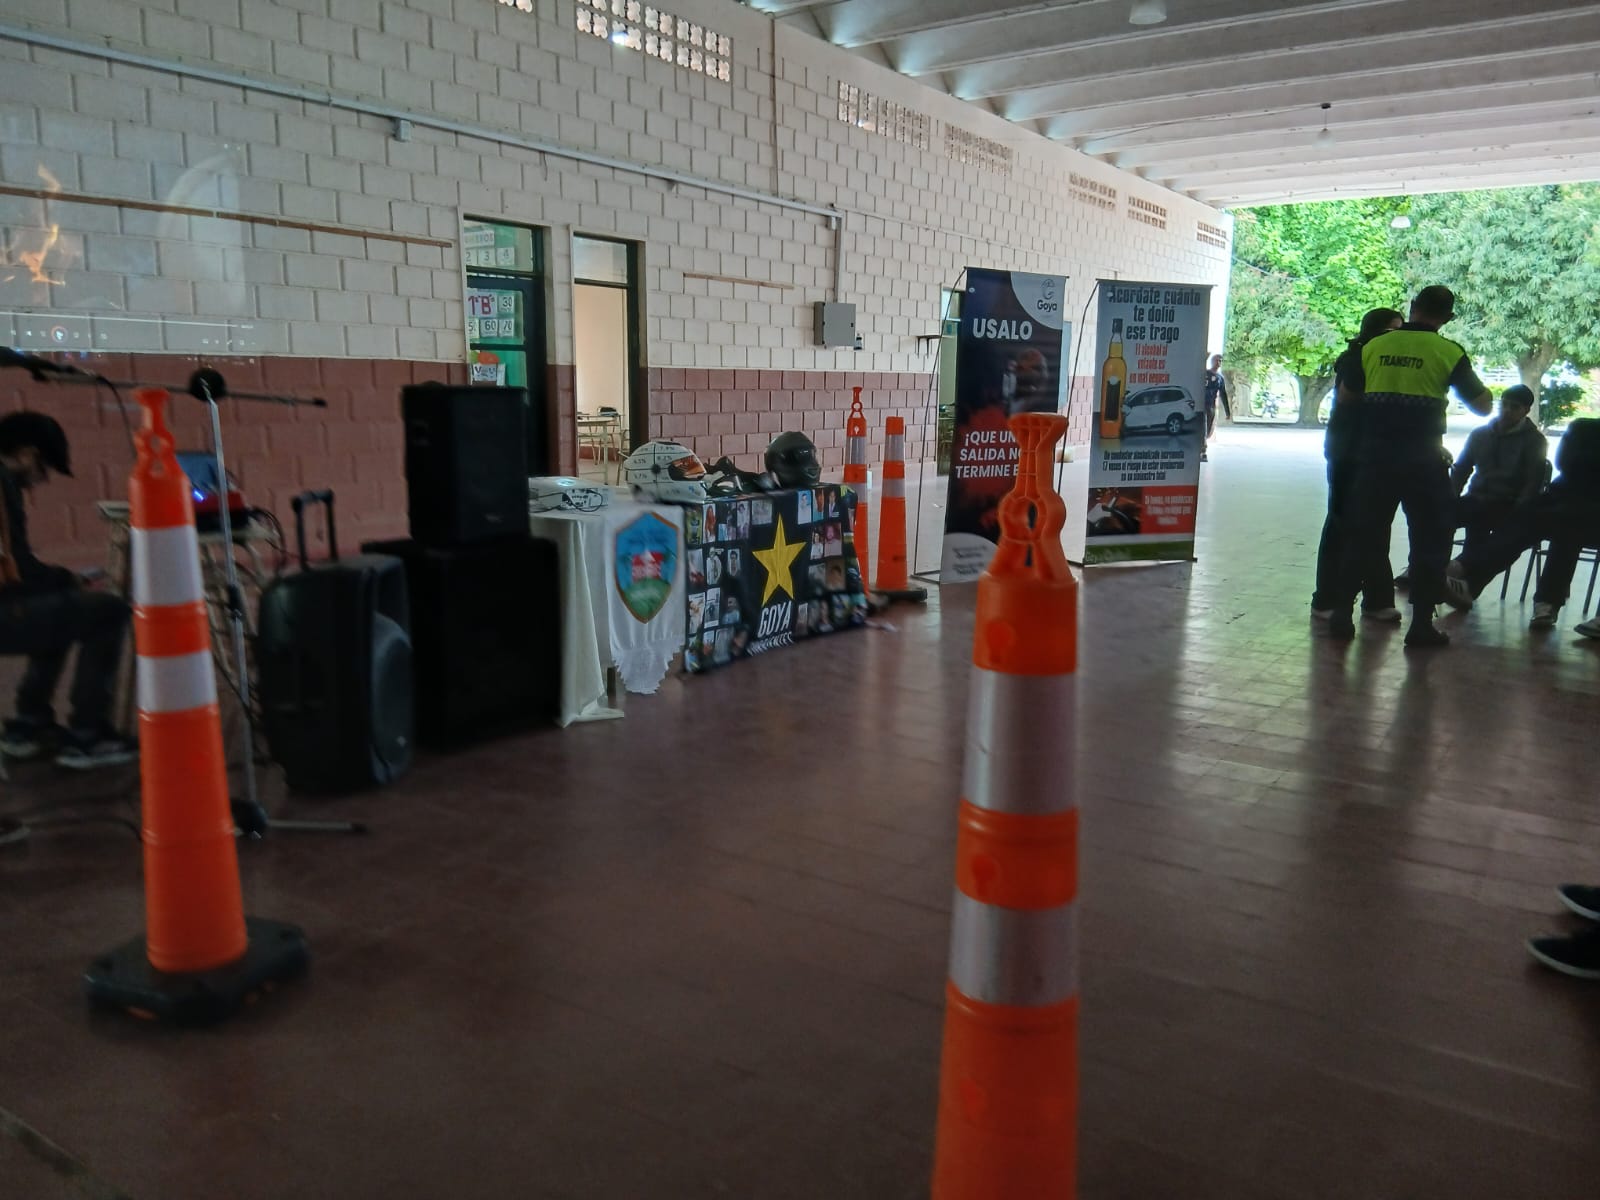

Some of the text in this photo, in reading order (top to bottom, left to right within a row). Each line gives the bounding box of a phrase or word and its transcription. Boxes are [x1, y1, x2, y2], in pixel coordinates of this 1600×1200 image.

[484, 251, 489, 261] 3
[1037, 300, 1058, 312] Goya
[1133, 305, 1144, 322] te
[485, 320, 496, 331] 60
[973, 318, 1033, 340] USALO
[1126, 324, 1180, 343] ese trago
[1379, 355, 1424, 369] TRANSITO
[1000, 430, 1016, 444] UN
[960, 447, 1022, 461] SALIDA N
[956, 465, 1010, 478] TERMINE
[757, 600, 792, 638] GOYA
